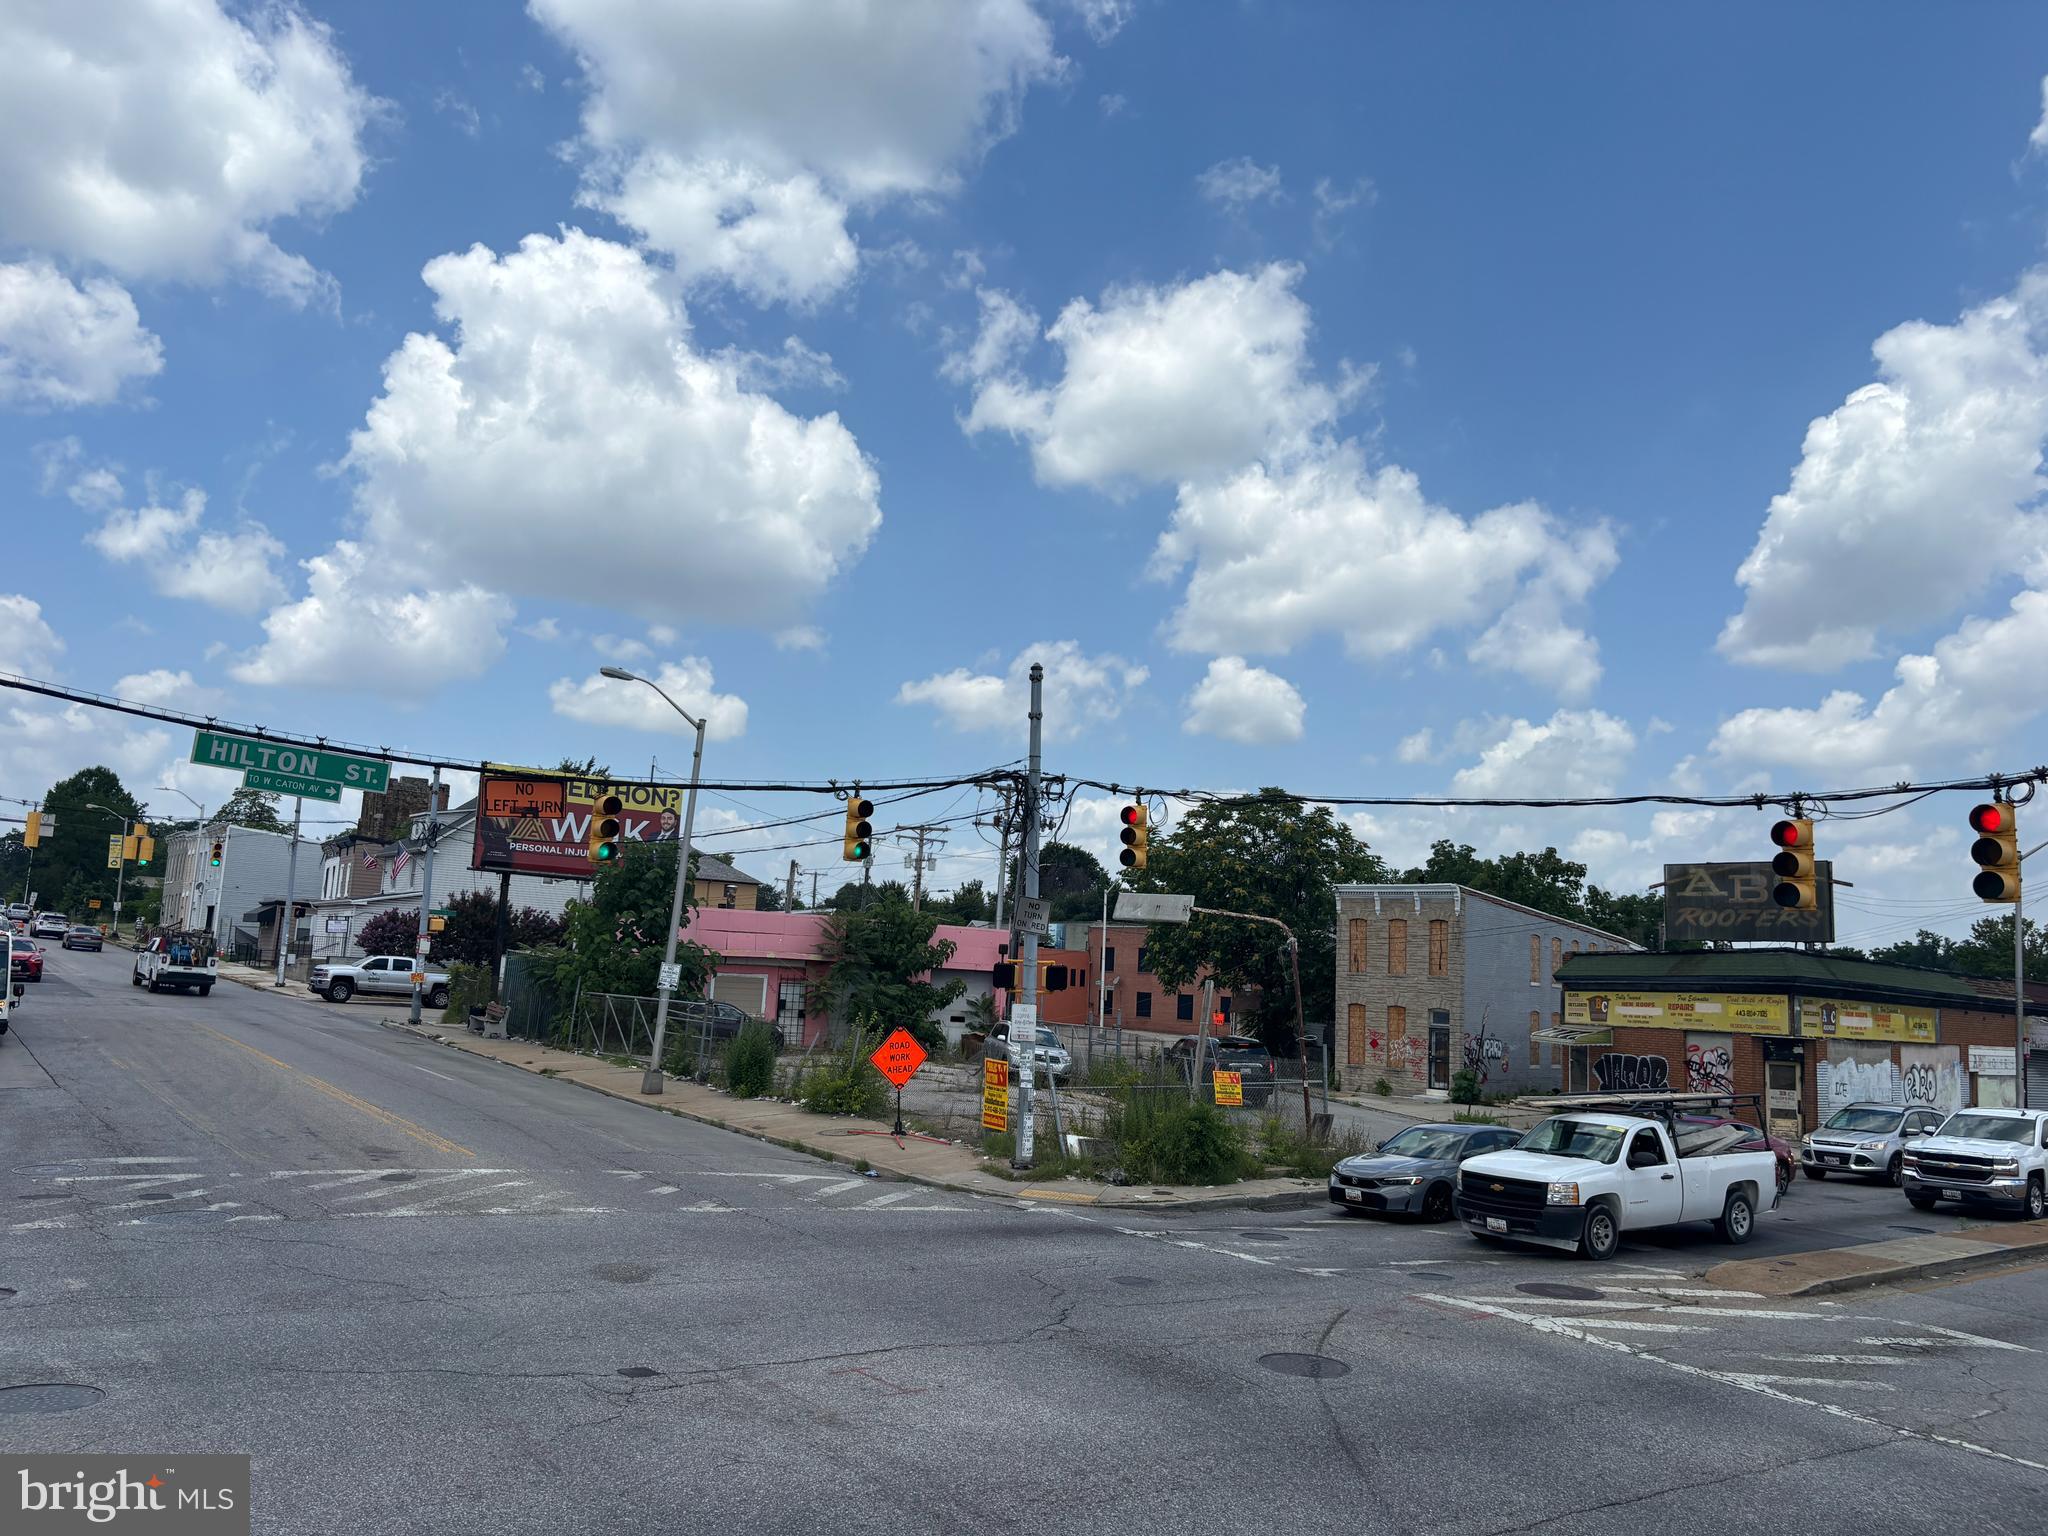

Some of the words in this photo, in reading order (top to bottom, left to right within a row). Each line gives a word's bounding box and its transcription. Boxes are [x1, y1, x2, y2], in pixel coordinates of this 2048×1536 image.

[209, 740, 319, 776] HILTON
[345, 764, 378, 784] ST.
[249, 774, 260, 784] TO
[263, 776, 272, 785] W
[275, 778, 305, 792] CATON
[308, 783, 320, 793] AV
[515, 783, 534, 796] NO
[615, 786, 681, 808] HON?
[486, 799, 519, 812] LEFT
[528, 800, 563, 814] TURN
[509, 842, 562, 855] PERSONAL
[1676, 867, 1782, 904] AB
[1028, 901, 1040, 910] NO
[1024, 910, 1043, 920] TURN
[1674, 905, 1824, 929] ROOFERS
[1016, 919, 1027, 928] ON
[1031, 921, 1046, 931] RED
[1667, 1003, 1694, 1011] REPAIRS
[889, 1041, 910, 1050] ROAD
[889, 1053, 911, 1062] WORK
[887, 1065, 913, 1074] AHEAD
